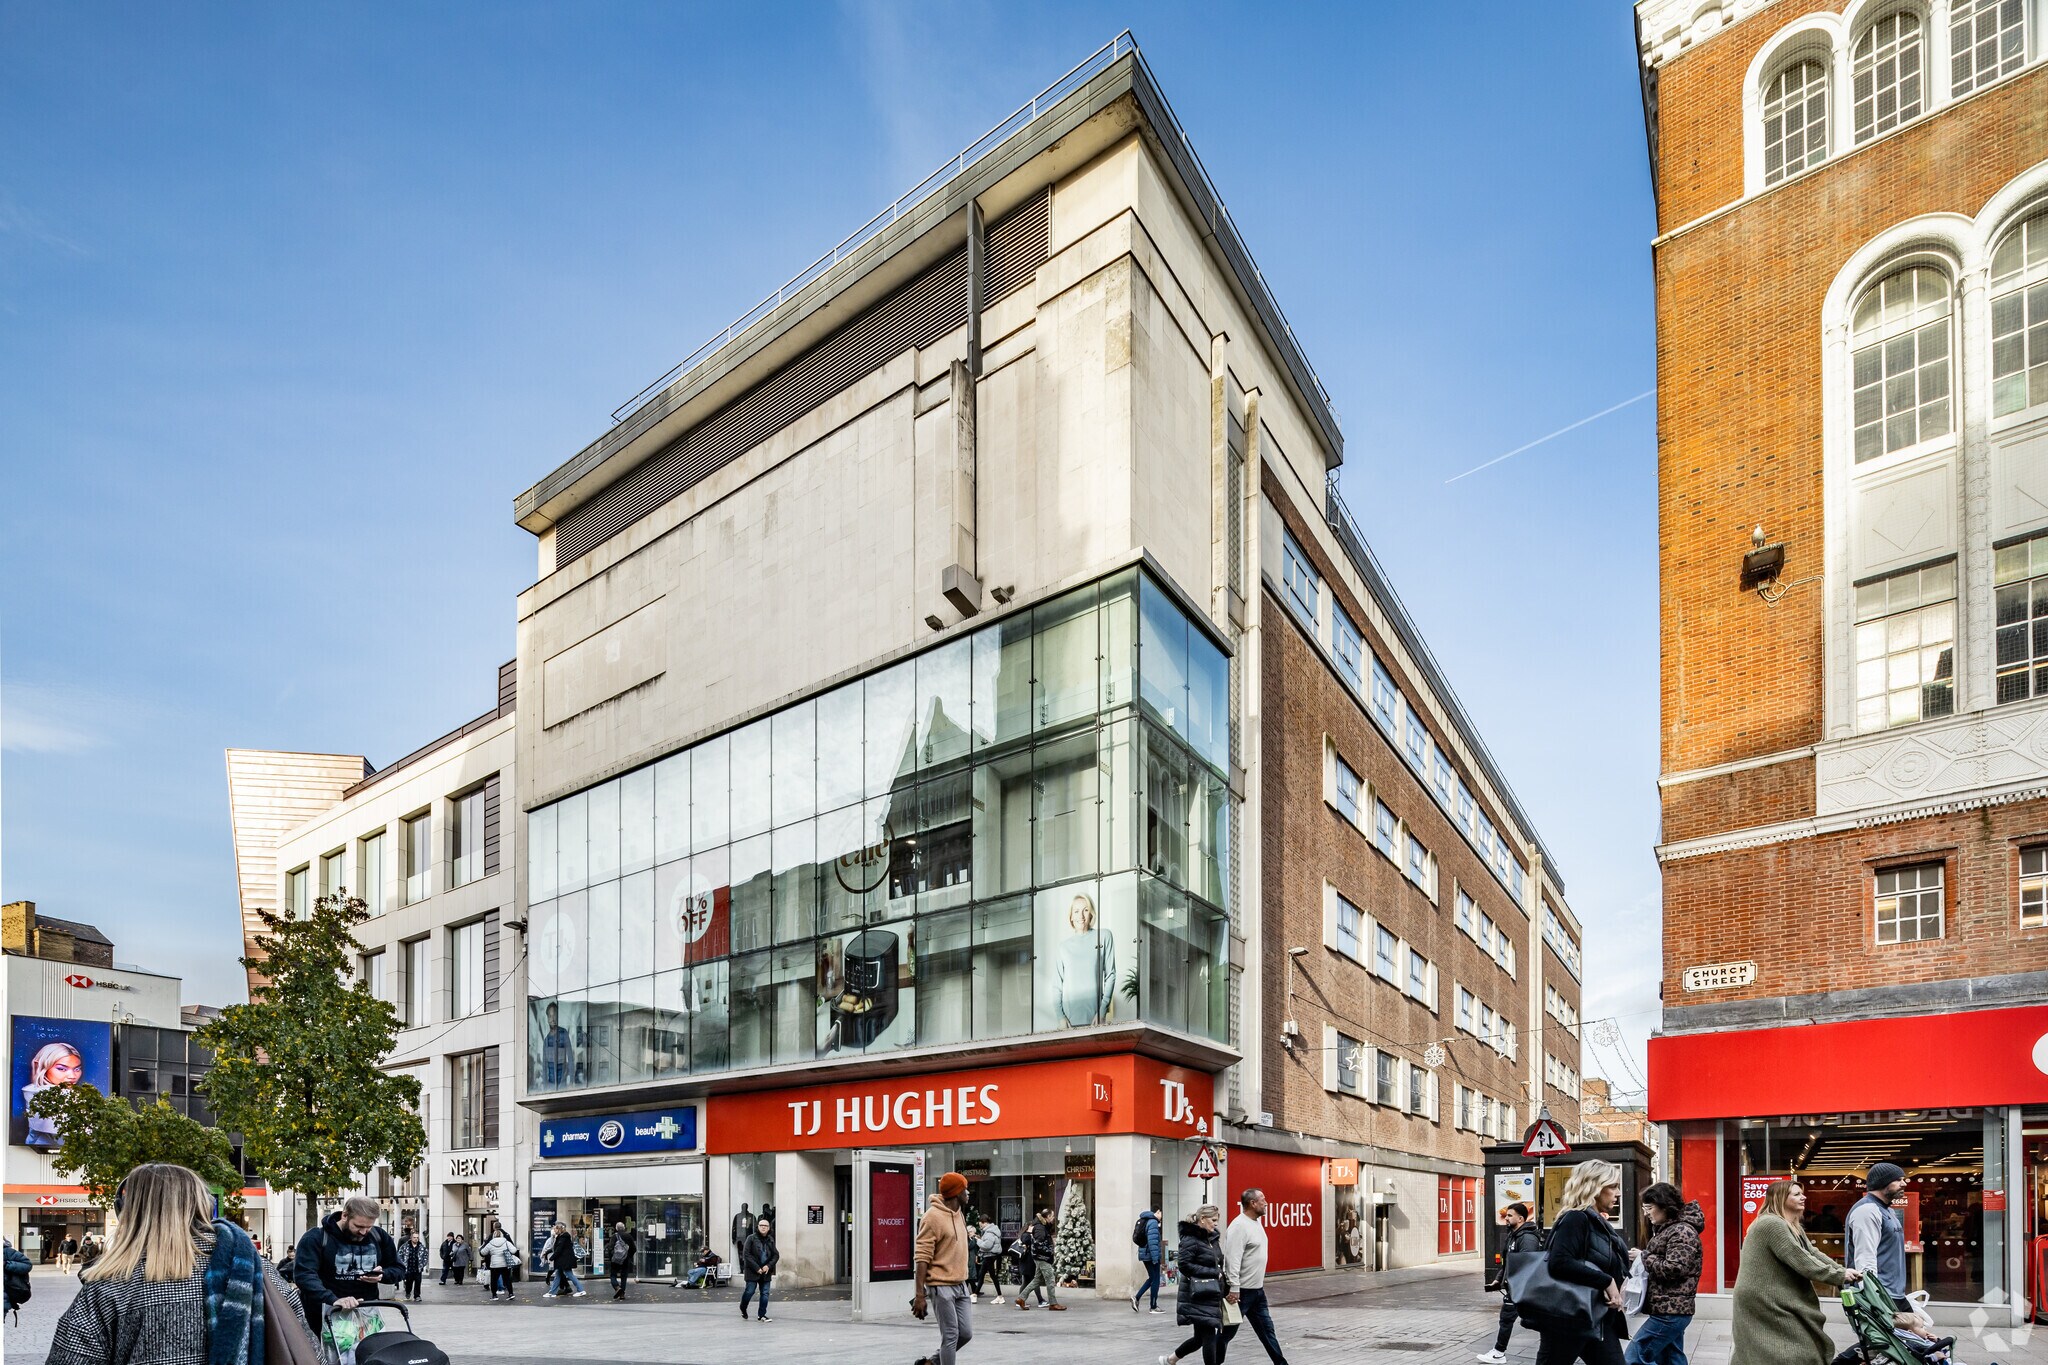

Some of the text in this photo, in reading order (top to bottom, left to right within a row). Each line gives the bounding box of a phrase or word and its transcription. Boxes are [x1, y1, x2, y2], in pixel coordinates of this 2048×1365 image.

[677, 909, 708, 934] OFF
[1692, 965, 1747, 978] CHURCH
[96, 981, 119, 990] HSBC
[1694, 975, 1747, 987] STREET
[1093, 1083, 1109, 1102] TJ's
[1160, 1078, 1194, 1125] TJ's
[788, 1084, 1001, 1136] TJ HUGHES
[562, 1131, 590, 1143] pharmacy
[600, 1123, 618, 1142] Boots
[635, 1126, 657, 1137] beauty
[450, 1158, 488, 1176] NEXT
[1066, 1165, 1096, 1174] CHRISTM
[1335, 1165, 1354, 1178] TJ's
[1743, 1182, 1769, 1191] Save
[484, 1190, 499, 1200] COST
[1743, 1190, 1767, 1199] £684
[1260, 1202, 1313, 1228] HUGHES
[877, 1218, 905, 1226] TANGOBET
